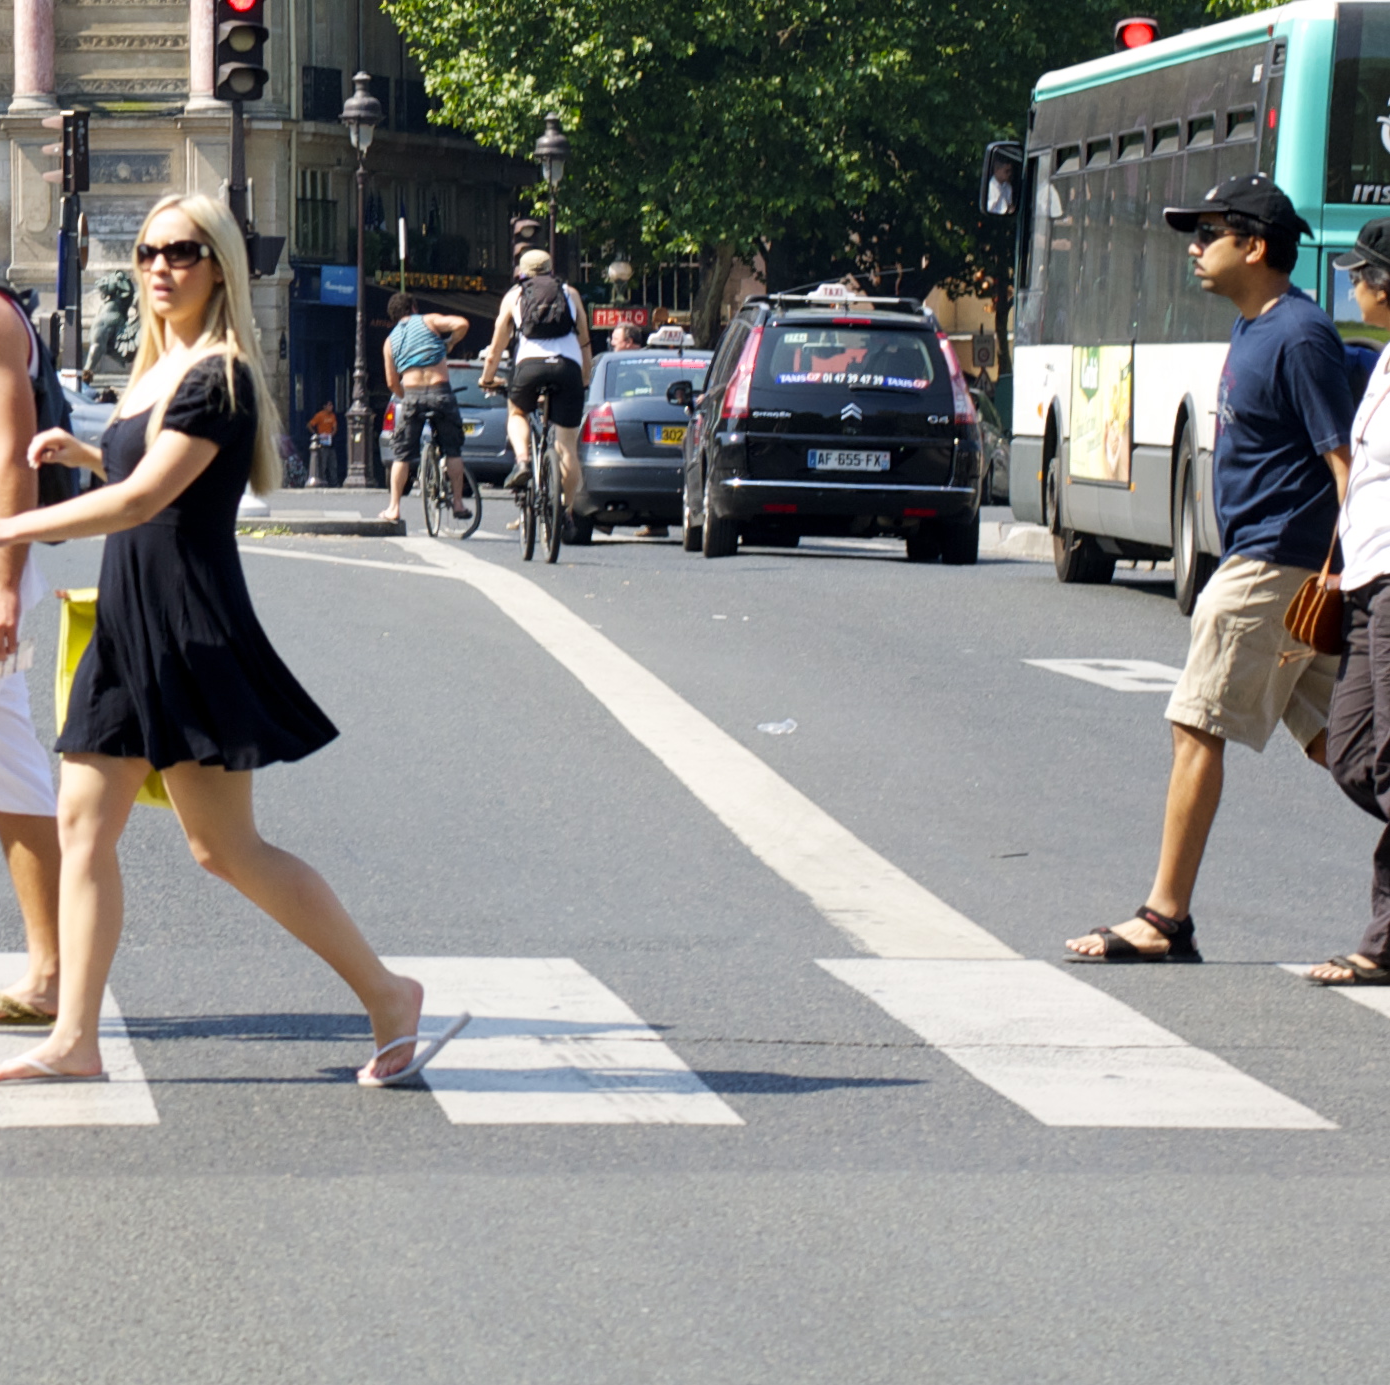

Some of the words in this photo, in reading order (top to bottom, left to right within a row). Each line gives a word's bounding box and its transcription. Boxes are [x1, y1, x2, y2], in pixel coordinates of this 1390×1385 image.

[824, 287, 844, 297] TAXI
[822, 373, 833, 383] 01
[834, 373, 846, 384] 47
[847, 374, 859, 384] 39
[860, 374, 872, 385] 47
[873, 375, 884, 385] 39
[662, 428, 683, 441] 302
